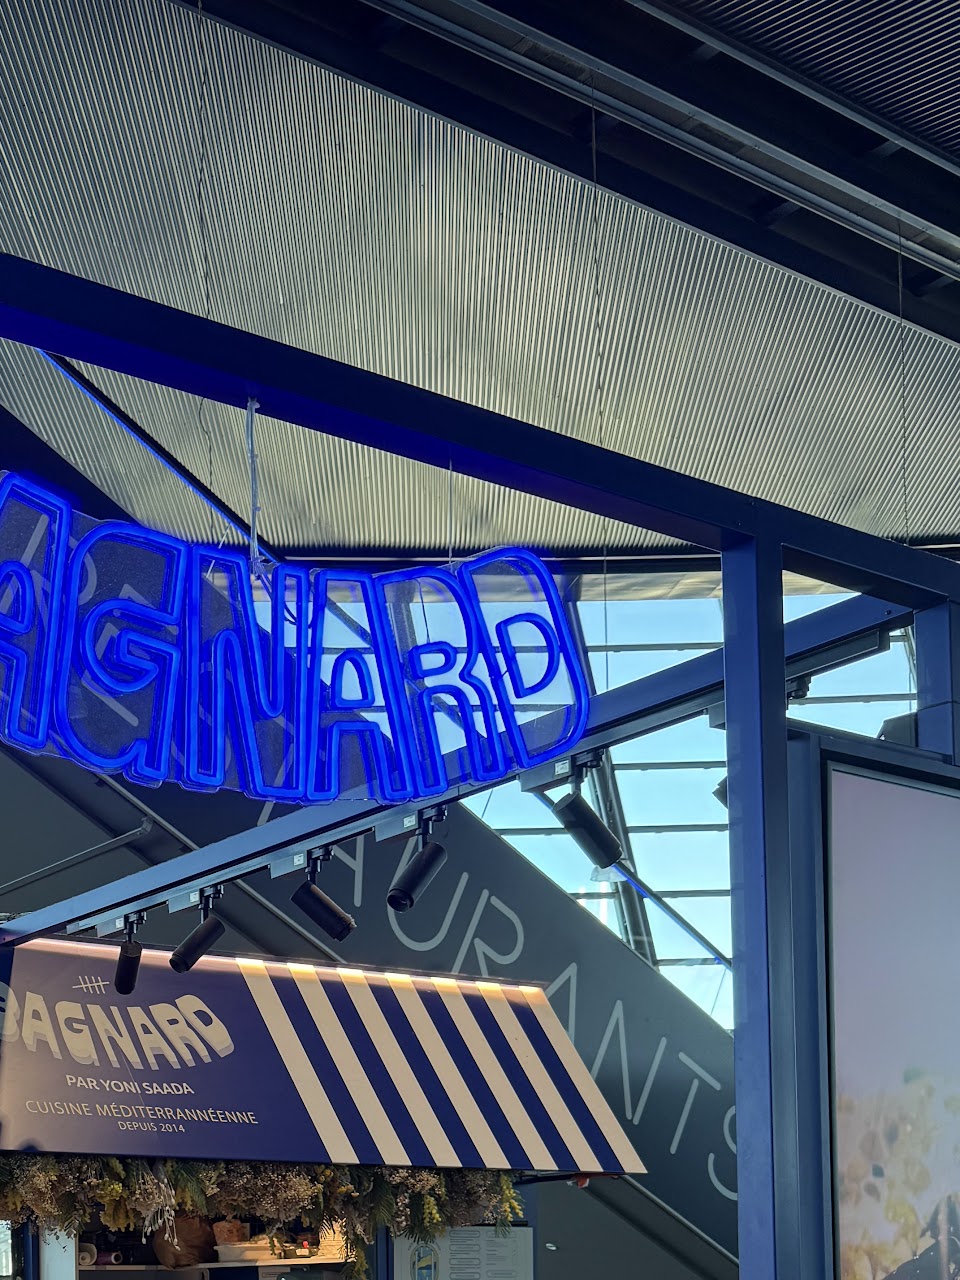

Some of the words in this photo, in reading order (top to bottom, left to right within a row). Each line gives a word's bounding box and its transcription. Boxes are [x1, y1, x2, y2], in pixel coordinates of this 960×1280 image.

[66, 1075, 100, 1090] PAR
[100, 1079, 140, 1094] YONI
[142, 1082, 195, 1096] SAADA
[25, 1100, 92, 1116] CUISINE
[95, 1102, 259, 1124] MÉDITERRANNÉENNE
[117, 1121, 157, 1132] DEPUIS
[159, 1123, 185, 1133] 2014
